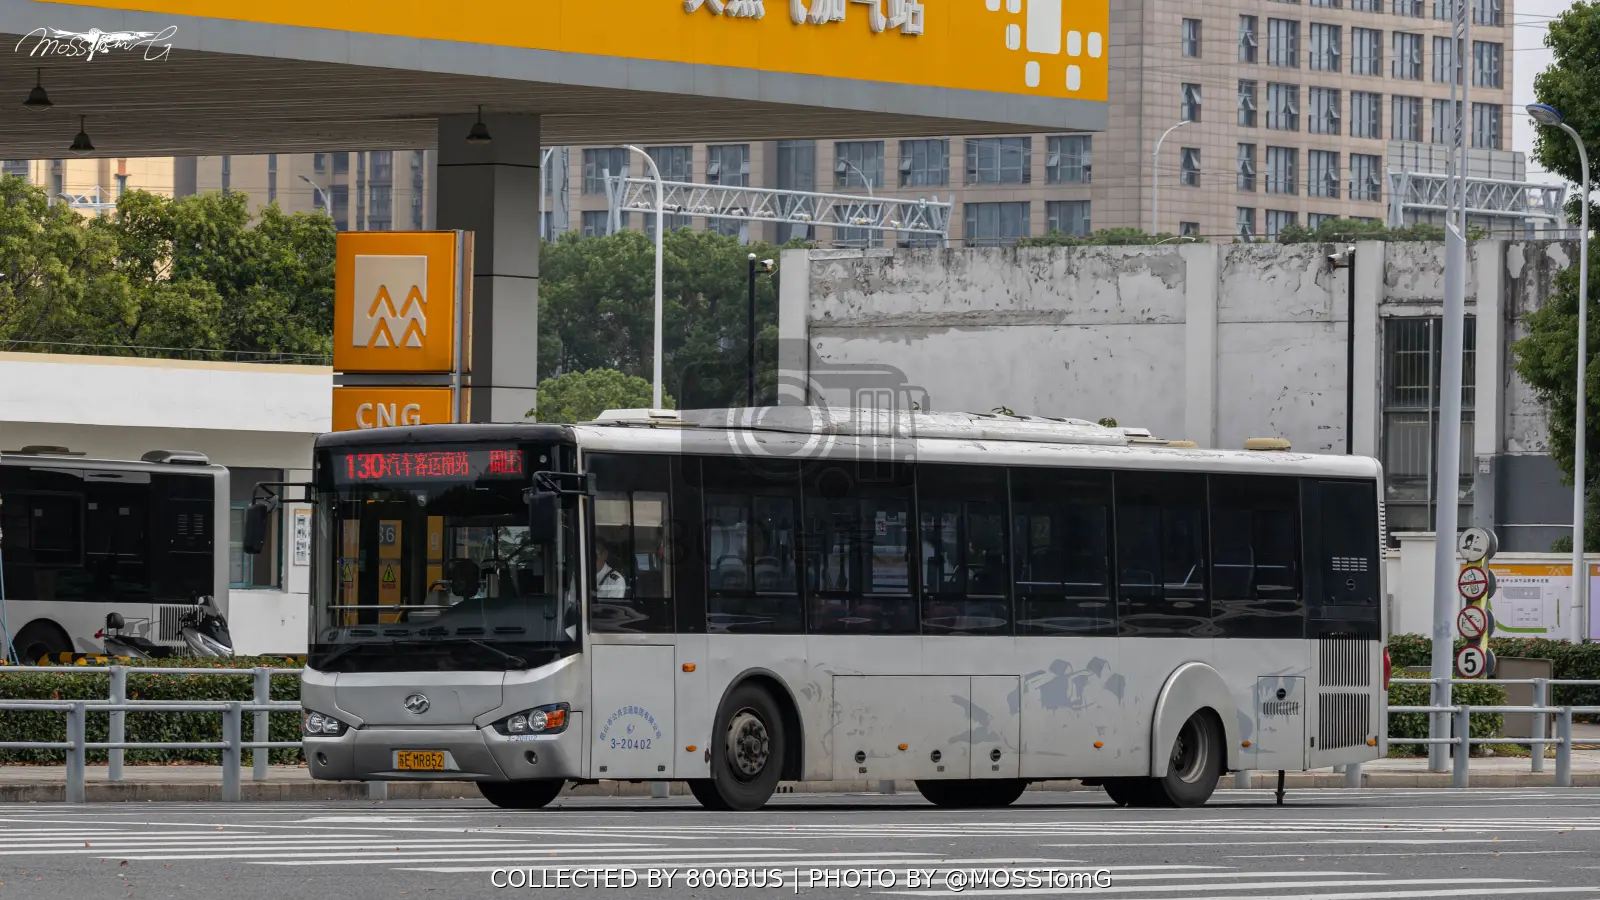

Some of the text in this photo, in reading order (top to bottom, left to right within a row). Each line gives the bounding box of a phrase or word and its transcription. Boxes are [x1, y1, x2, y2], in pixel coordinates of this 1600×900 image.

[356, 402, 421, 429] CNG
[345, 453, 384, 479] 130
[385, 451, 469, 477] 汽车客运南站
[1463, 651, 1477, 674] 5
[610, 738, 652, 750] 3-20402
